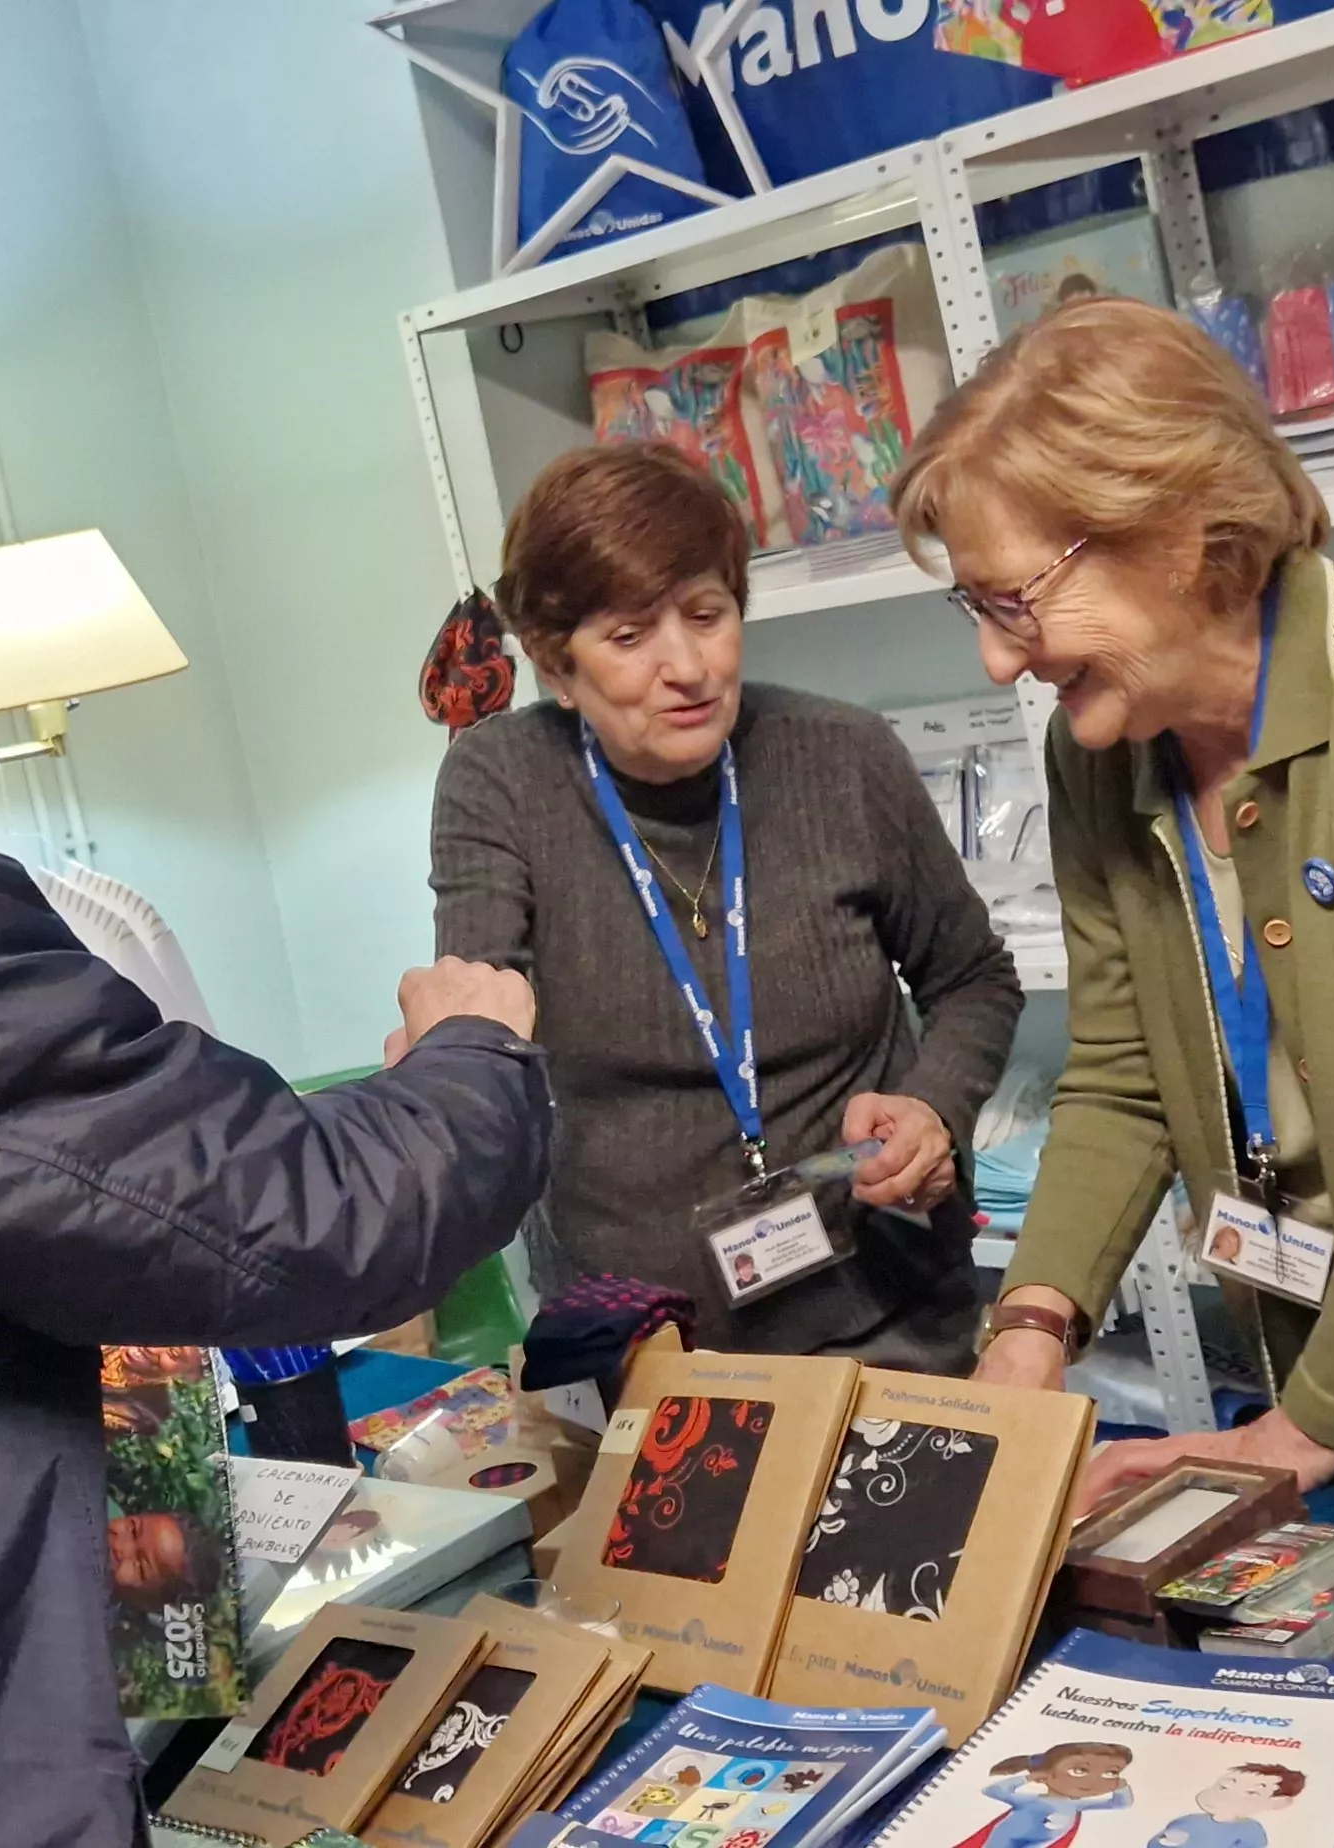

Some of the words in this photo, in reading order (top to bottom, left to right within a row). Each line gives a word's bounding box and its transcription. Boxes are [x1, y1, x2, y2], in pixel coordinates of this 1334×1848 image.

[616, 211, 664, 231] Unidas
[722, 1234, 758, 1256] Manos
[774, 1211, 813, 1234] Unidas
[1217, 1209, 1258, 1232] Manos
[1281, 1233, 1326, 1258] Unidas
[881, 1388, 936, 1405] Pashmina
[938, 1396, 991, 1415] Solidaria
[257, 1468, 350, 1488] CALENDARIO
[274, 1490, 295, 1505] DE
[237, 1509, 311, 1530] ADVIENTO
[163, 1603, 195, 1679] 2025
[192, 1603, 208, 1678] Calendario
[845, 1661, 889, 1683] Manos
[917, 1677, 966, 1701] Unidas
[1211, 1678, 1272, 1689] CAMPAÑA
[1274, 1682, 1326, 1694] CONTRA
[1215, 1668, 1286, 1682] Manos
[1057, 1687, 1139, 1712] Nuestros
[1141, 1700, 1294, 1729] Superhéroes
[678, 1722, 721, 1744] Una
[716, 1735, 796, 1751] palabra
[1040, 1703, 1100, 1726] luchan
[1102, 1718, 1161, 1735] contra
[1165, 1723, 1183, 1738] la
[1187, 1726, 1303, 1750] indiferencia
